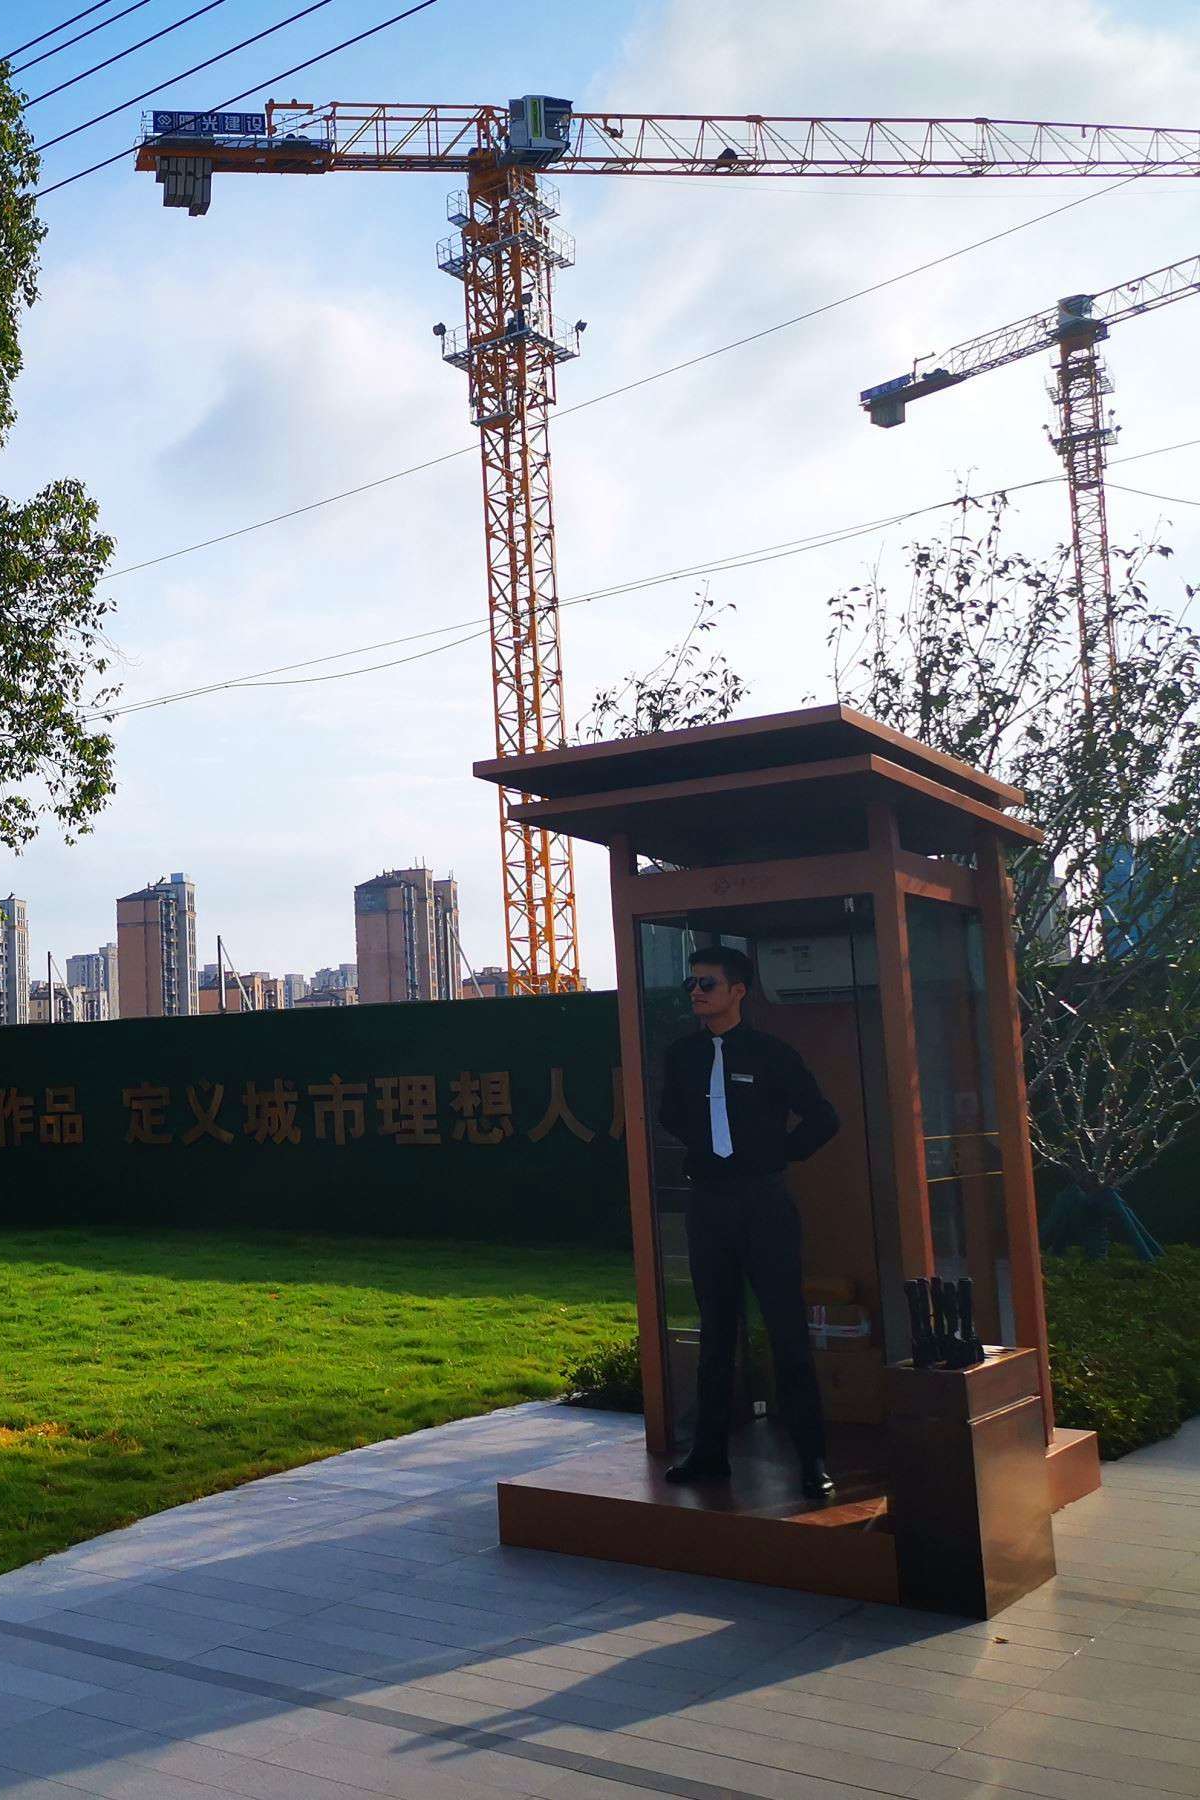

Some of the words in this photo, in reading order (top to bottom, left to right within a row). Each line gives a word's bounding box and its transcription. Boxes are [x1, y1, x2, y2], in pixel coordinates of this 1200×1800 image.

[121, 1066, 622, 1146] 定义城市理想人
